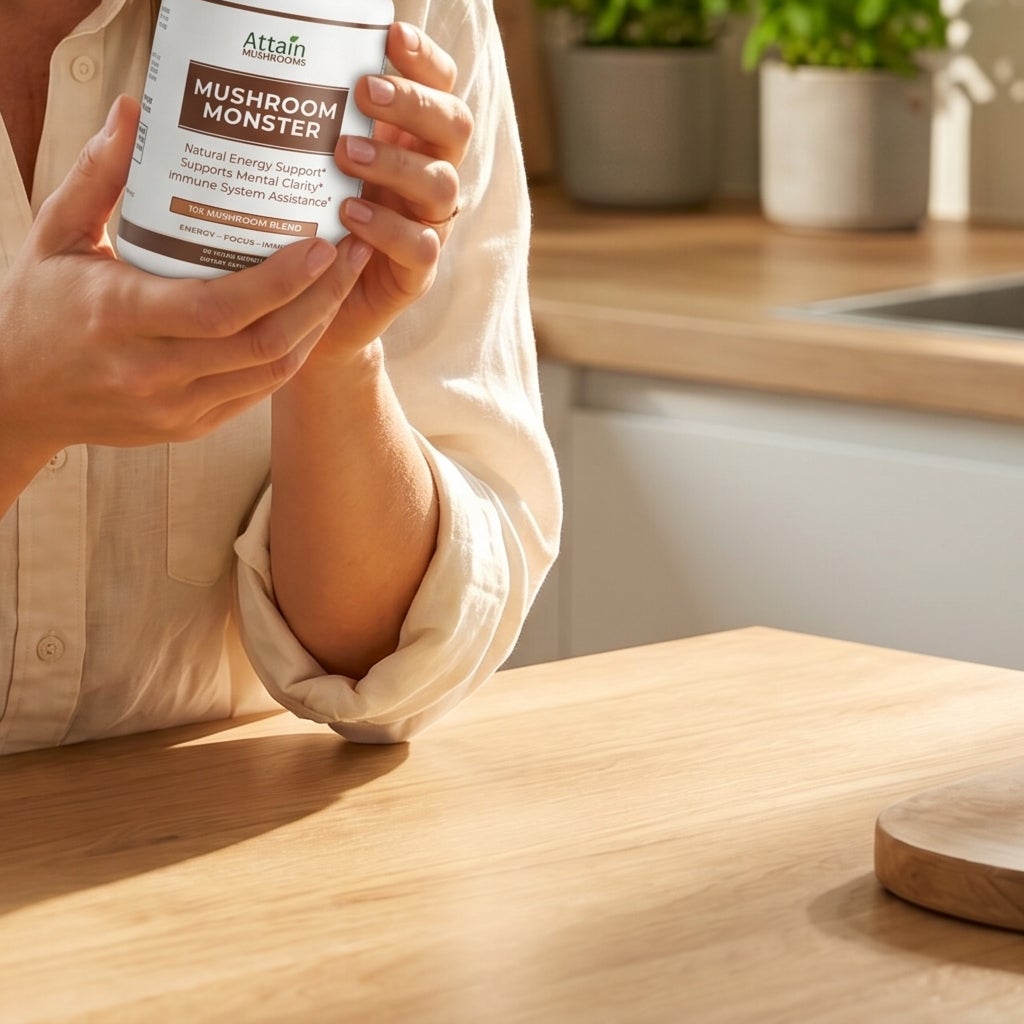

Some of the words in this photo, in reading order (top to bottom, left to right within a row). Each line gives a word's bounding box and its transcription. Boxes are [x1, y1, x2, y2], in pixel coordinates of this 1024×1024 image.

[242, 49, 306, 66] MUSHROOMS
[243, 32, 306, 58] Attain
[194, 78, 338, 120] MUSHROOM
[203, 102, 321, 139] MONSTER
[184, 143, 227, 162] Natural
[229, 154, 273, 172] Energy
[180, 157, 233, 178] Supports
[236, 170, 279, 187] Mental
[220, 182, 266, 199] System
[206, 209, 268, 227] MUSHROOM
[269, 221, 303, 232] BLEND
[223, 234, 255, 246] FOCUS
